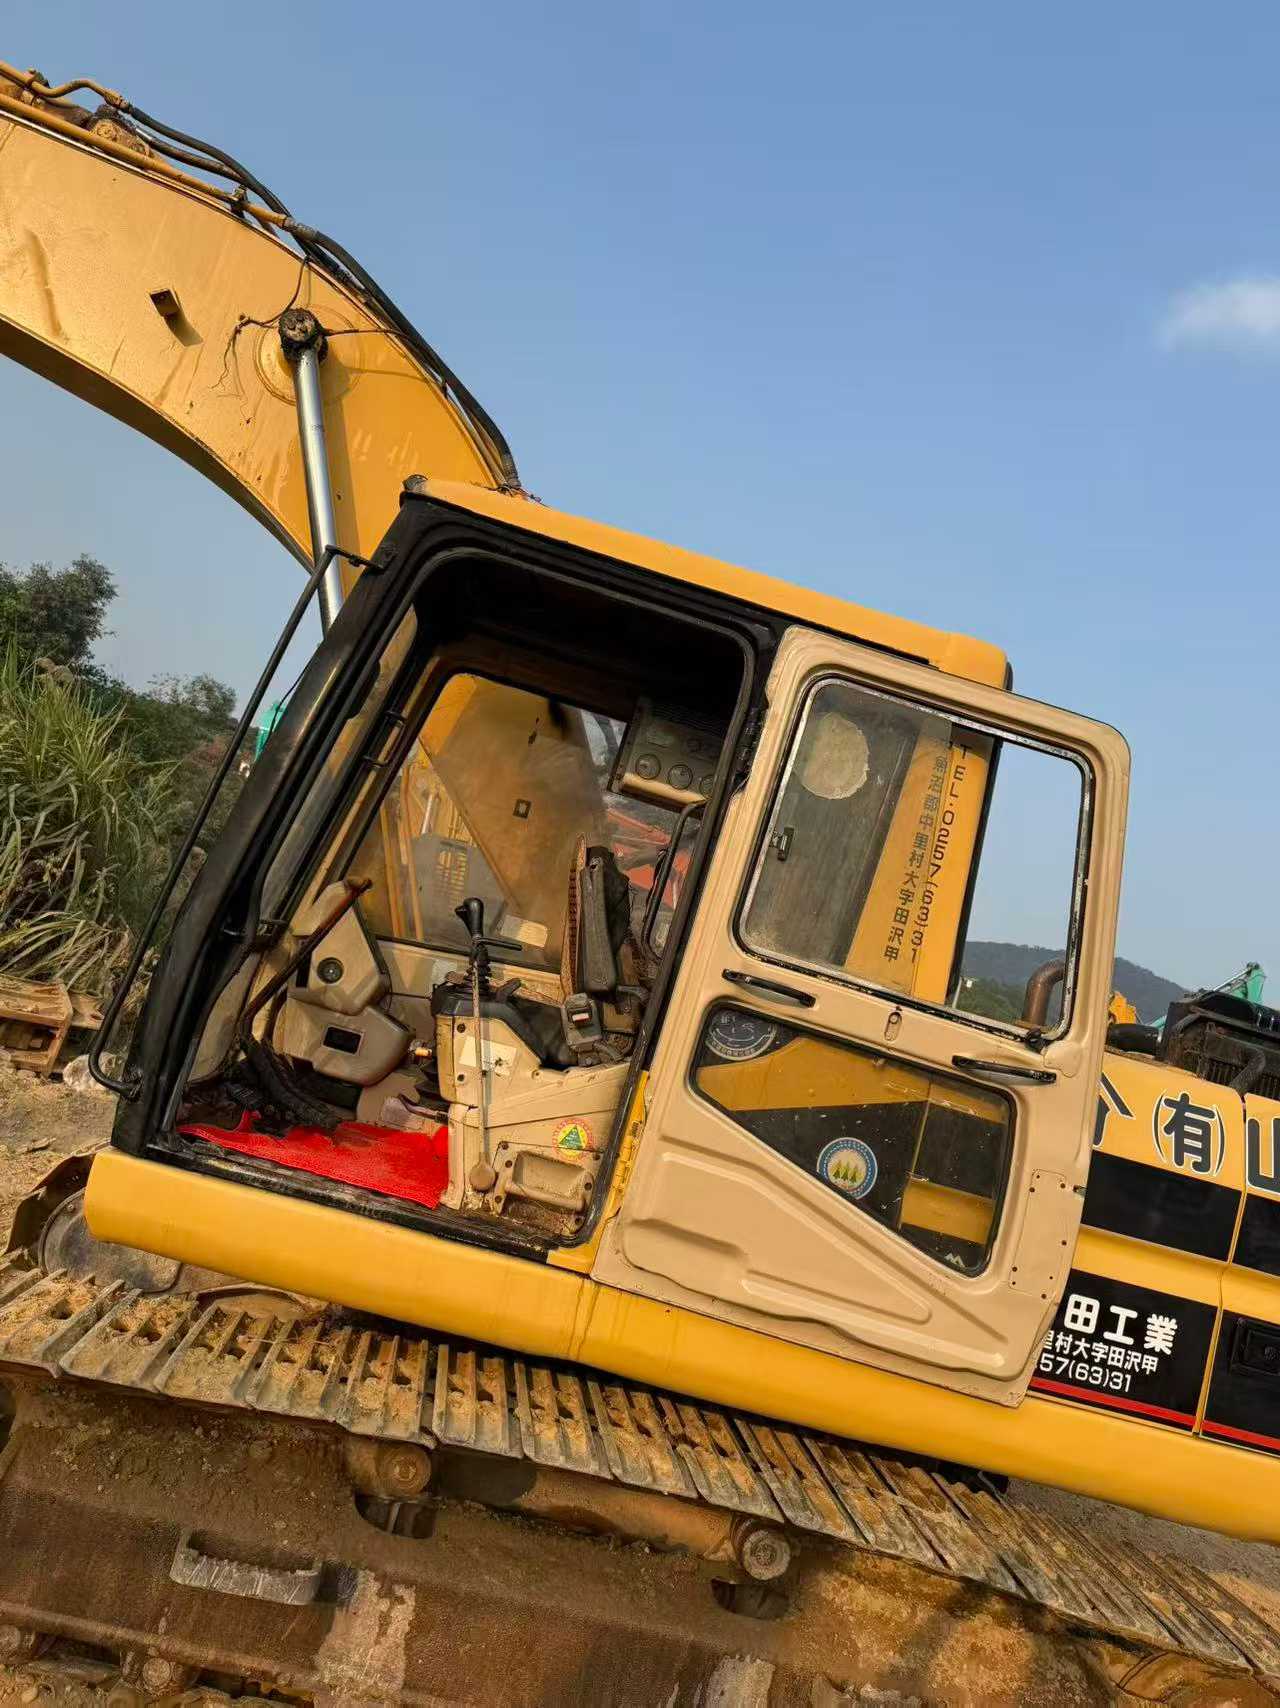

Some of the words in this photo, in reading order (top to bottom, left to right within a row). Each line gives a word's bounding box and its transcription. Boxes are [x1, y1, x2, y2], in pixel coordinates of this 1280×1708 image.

[1063, 1293, 1178, 1356] 田工業
[1039, 1354, 1132, 1393] 57(63)31
